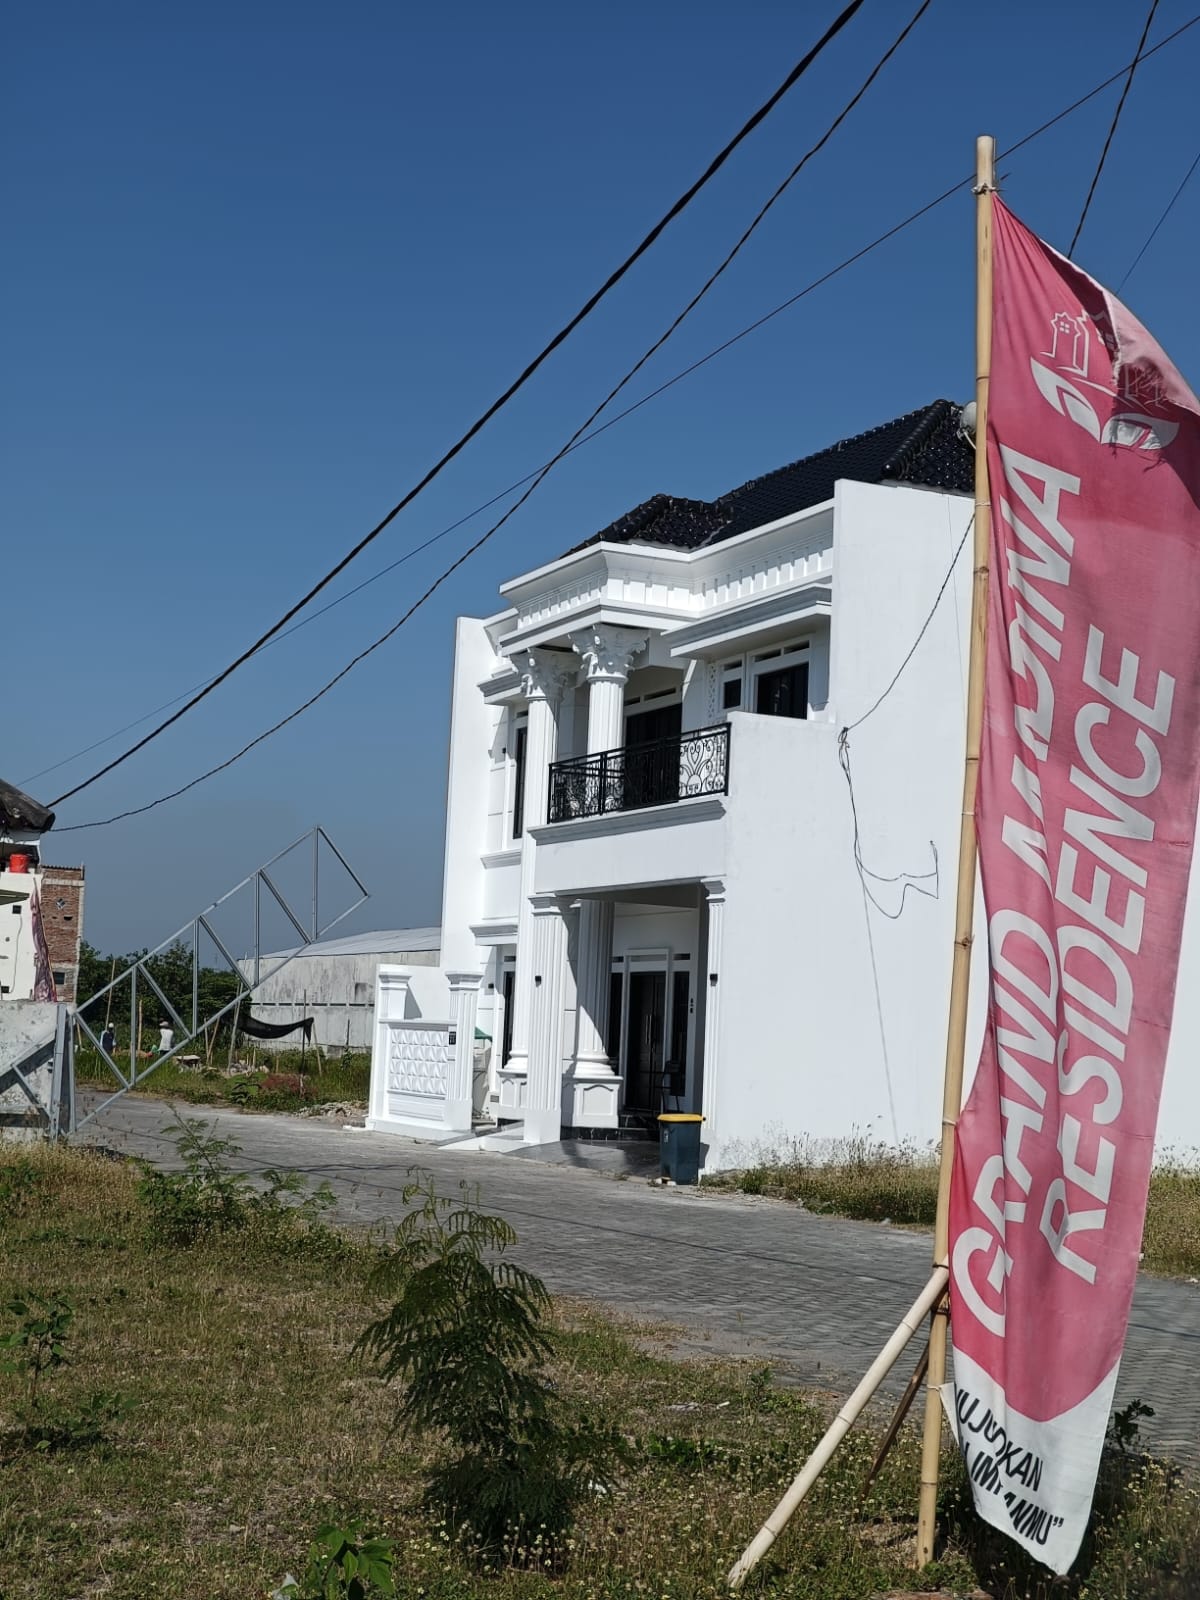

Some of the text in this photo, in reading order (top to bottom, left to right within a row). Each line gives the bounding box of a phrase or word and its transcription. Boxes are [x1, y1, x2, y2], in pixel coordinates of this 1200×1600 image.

[952, 442, 1082, 1338] GRAND MDINA
[1039, 623, 1177, 1286] RESIDENCE
[956, 1388, 1044, 1492] UJUDKAN
